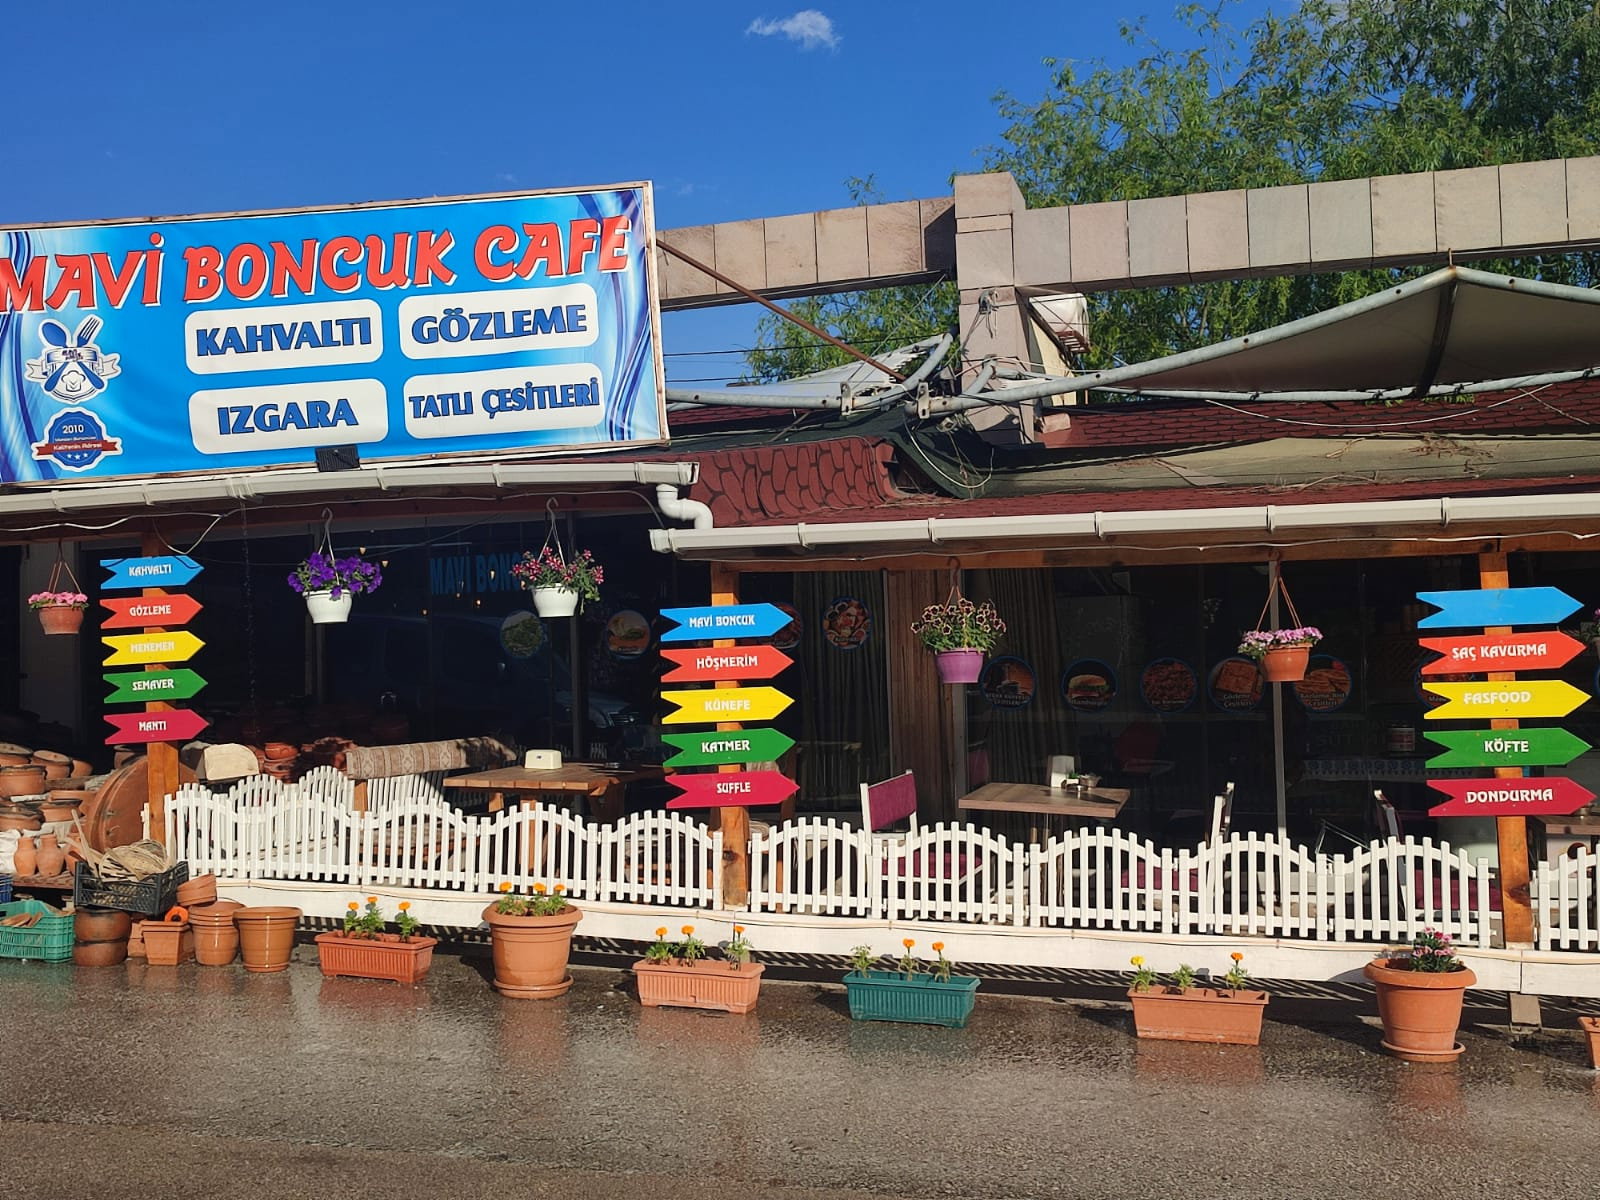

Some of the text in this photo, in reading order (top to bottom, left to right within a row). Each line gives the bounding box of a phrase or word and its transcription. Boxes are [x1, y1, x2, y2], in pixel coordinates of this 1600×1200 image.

[0, 214, 632, 313] MAVİ BONCUK CAFE
[411, 304, 588, 345] GÖZLEME
[196, 316, 373, 357] KAHVALTI
[409, 377, 600, 420] TATLI ÇESİTLERİ
[217, 398, 359, 436] IZGARA
[62, 424, 84, 435] 2010
[128, 563, 172, 577] KAHVALTI
[129, 604, 172, 617] GÖZLEME
[715, 614, 756, 627] BONCUK
[130, 641, 175, 653] MENEMEN
[1480, 643, 1547, 658] KAVURMA
[696, 654, 758, 671] HÖŞMERİM
[132, 678, 174, 691] SEMAVER
[704, 698, 751, 711] KÜNEFE
[1463, 691, 1531, 705] FASFOOD
[138, 721, 167, 732] MANTI
[702, 740, 750, 753] KATMER
[1484, 738, 1529, 752] KÖFTE
[716, 781, 752, 794] SUFFLE
[1465, 788, 1553, 804] DONDURMA
